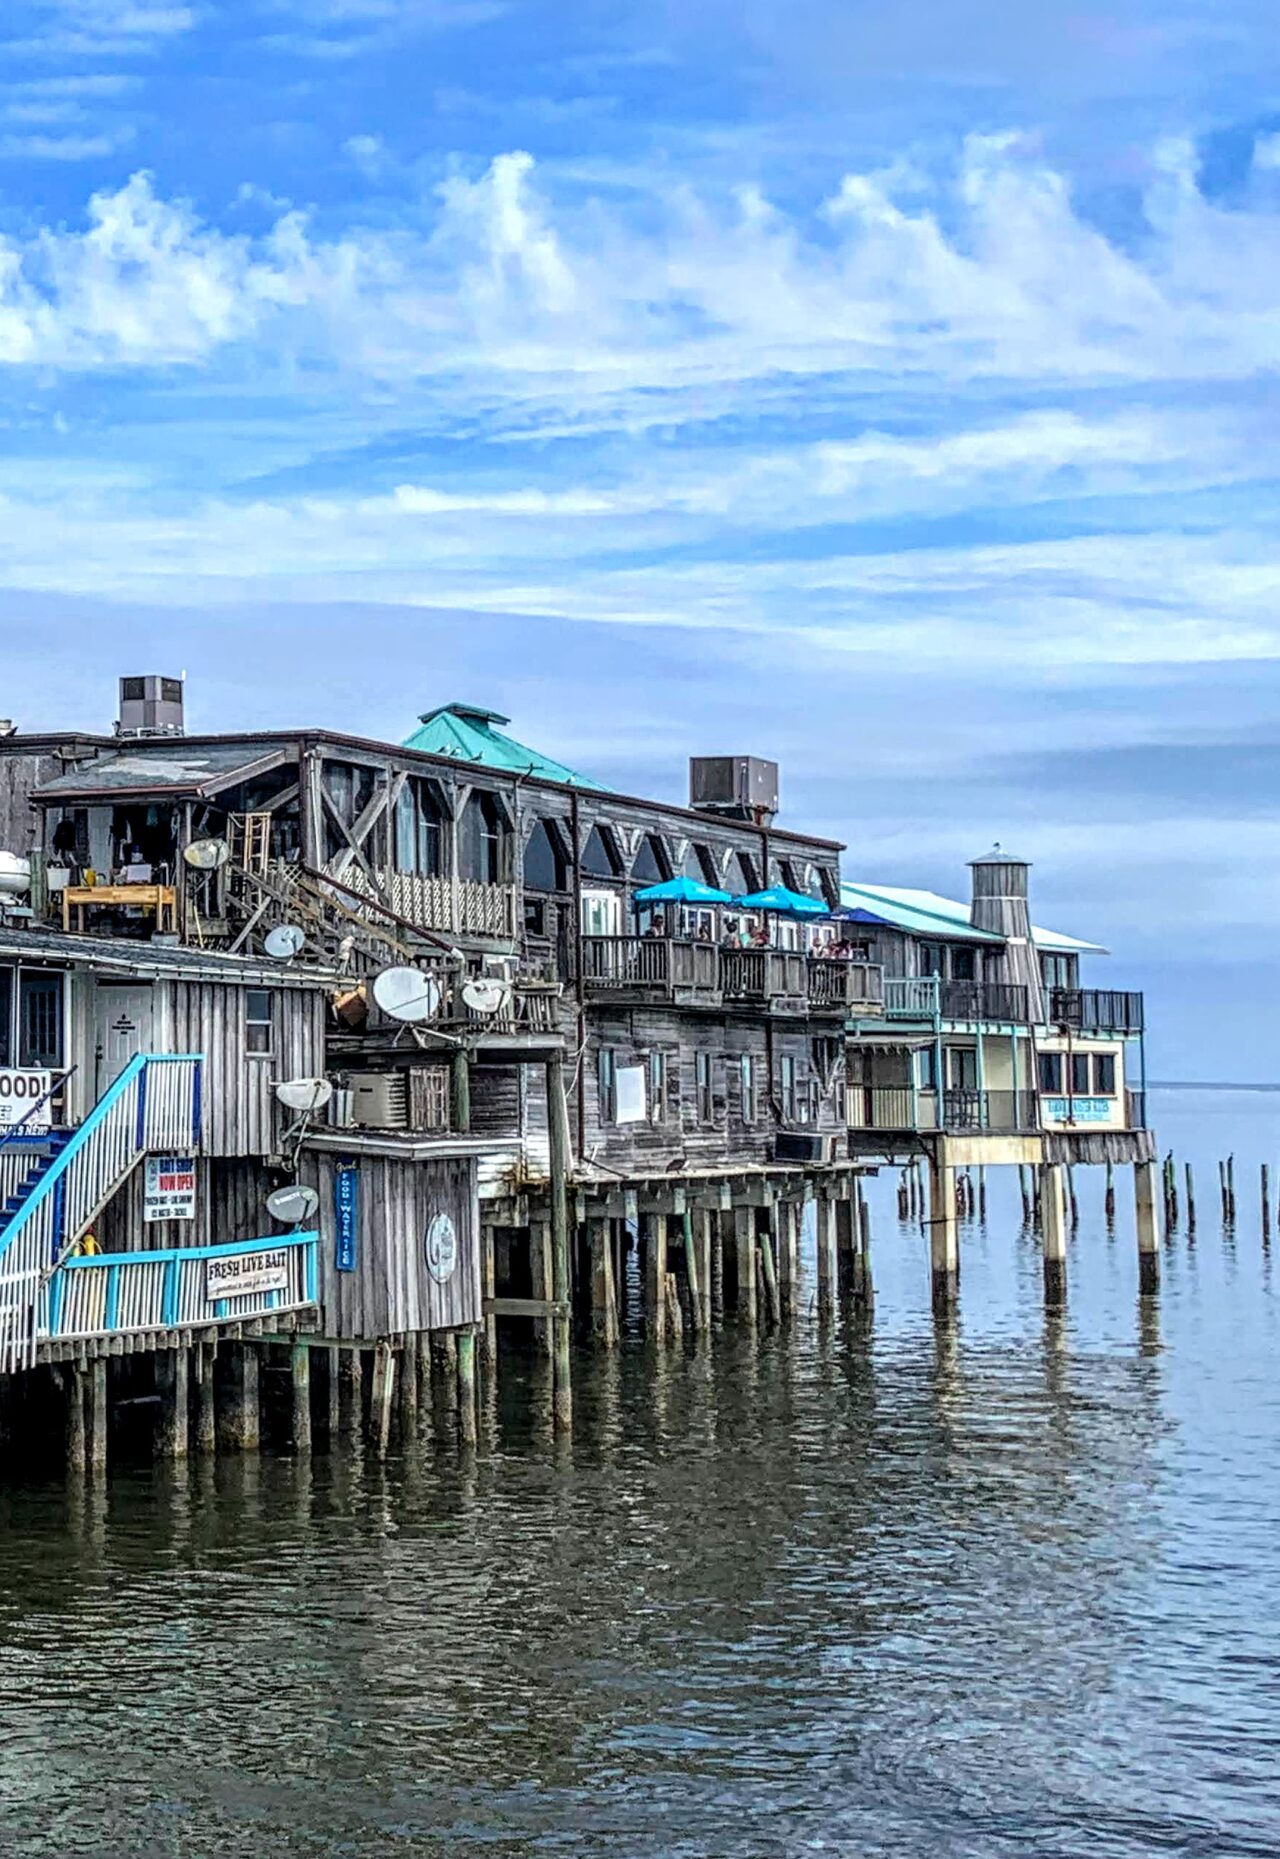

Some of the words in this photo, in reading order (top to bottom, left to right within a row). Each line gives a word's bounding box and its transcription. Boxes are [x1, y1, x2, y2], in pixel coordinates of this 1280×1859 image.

[159, 1175, 175, 1191] NOW
[177, 1174, 193, 1190] OPEN
[340, 1205, 351, 1238] WATER
[208, 1260, 240, 1280] FRESH
[242, 1255, 264, 1273] LIVE
[265, 1251, 286, 1269] BAIT
